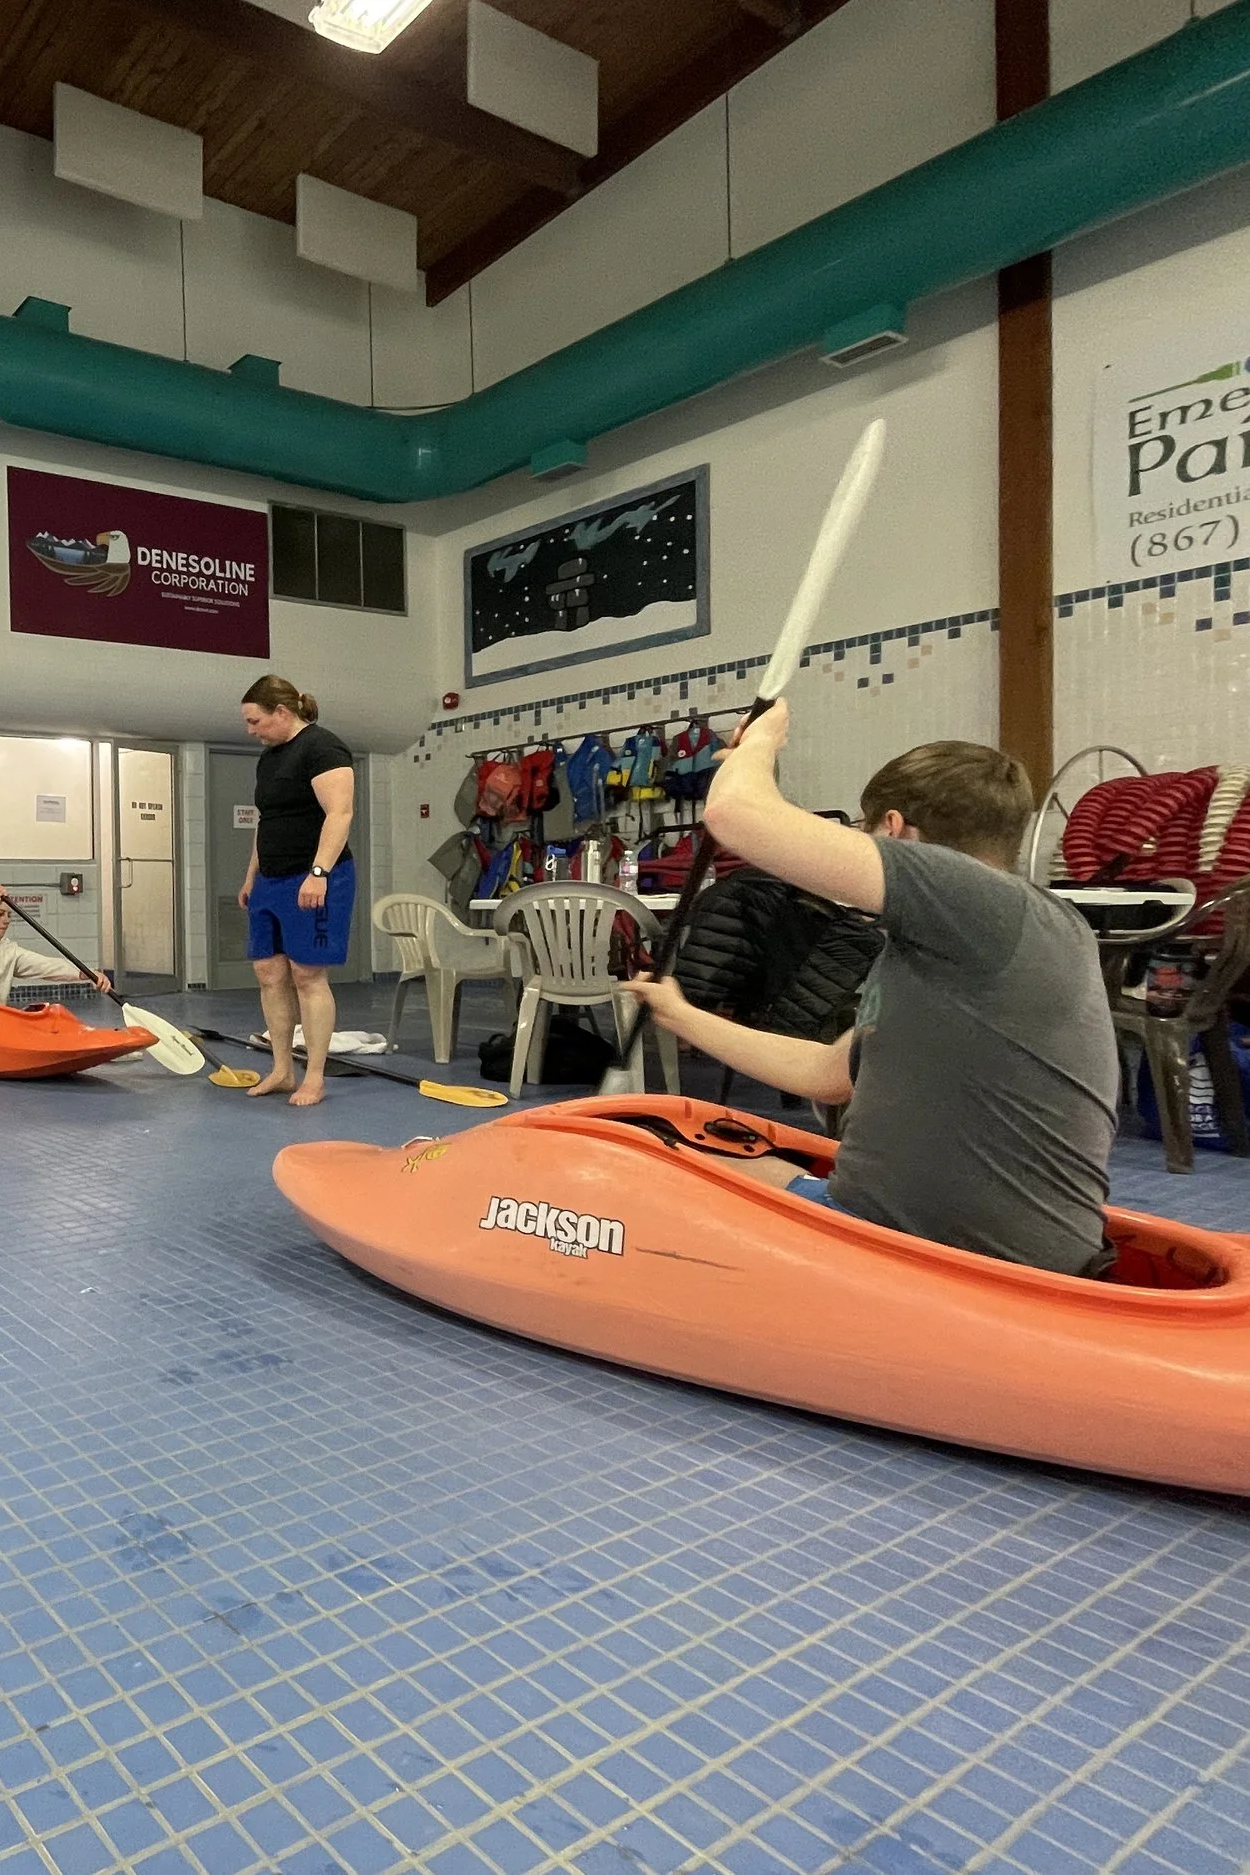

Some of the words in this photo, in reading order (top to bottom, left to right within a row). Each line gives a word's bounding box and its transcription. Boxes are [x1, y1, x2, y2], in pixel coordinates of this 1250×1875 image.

[1131, 514, 1239, 567] (867)
[137, 546, 255, 581] DENESOLINE
[151, 571, 248, 596] CORPORATION
